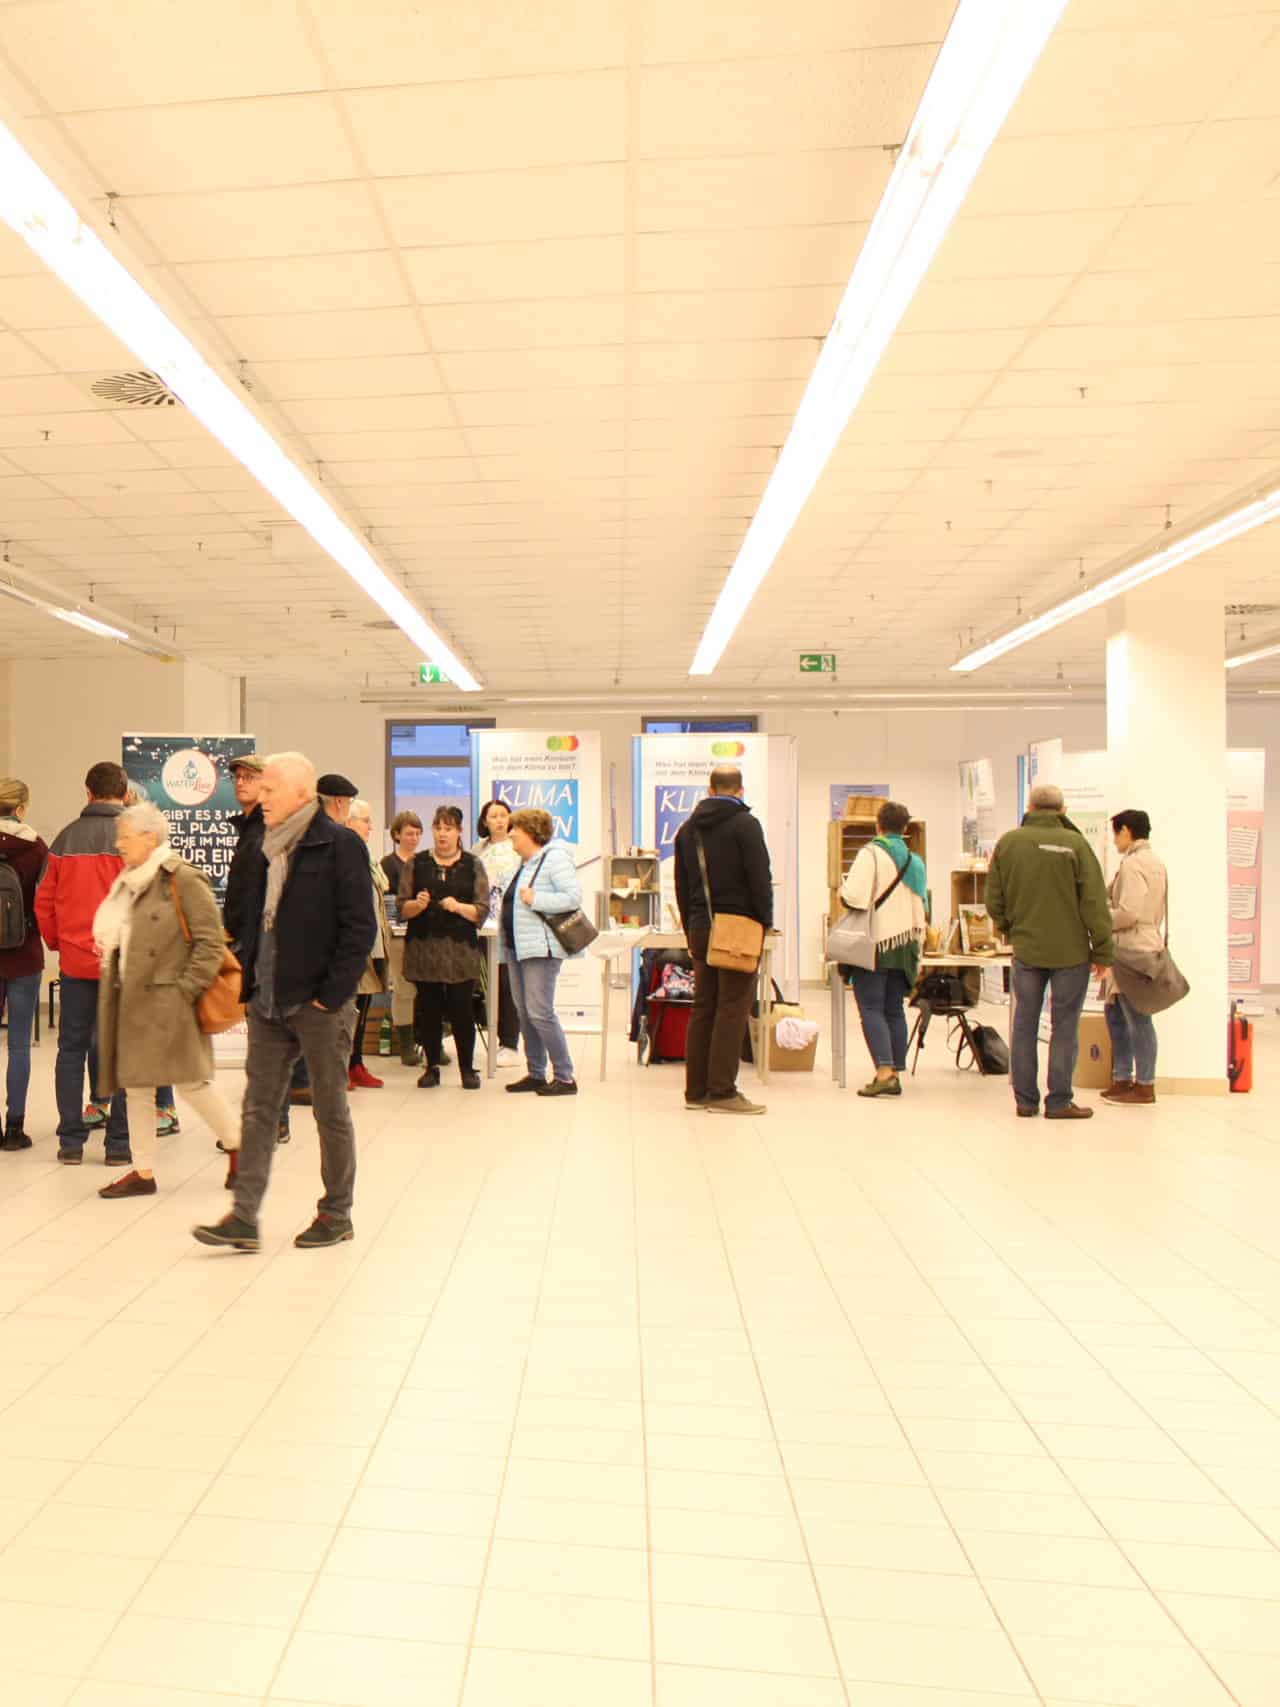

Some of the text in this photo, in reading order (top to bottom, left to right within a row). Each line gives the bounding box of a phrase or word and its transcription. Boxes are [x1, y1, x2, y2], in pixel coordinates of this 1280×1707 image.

[499, 783, 573, 807] KLIMA
[195, 809, 211, 821] ES
[199, 836, 213, 847] IM
